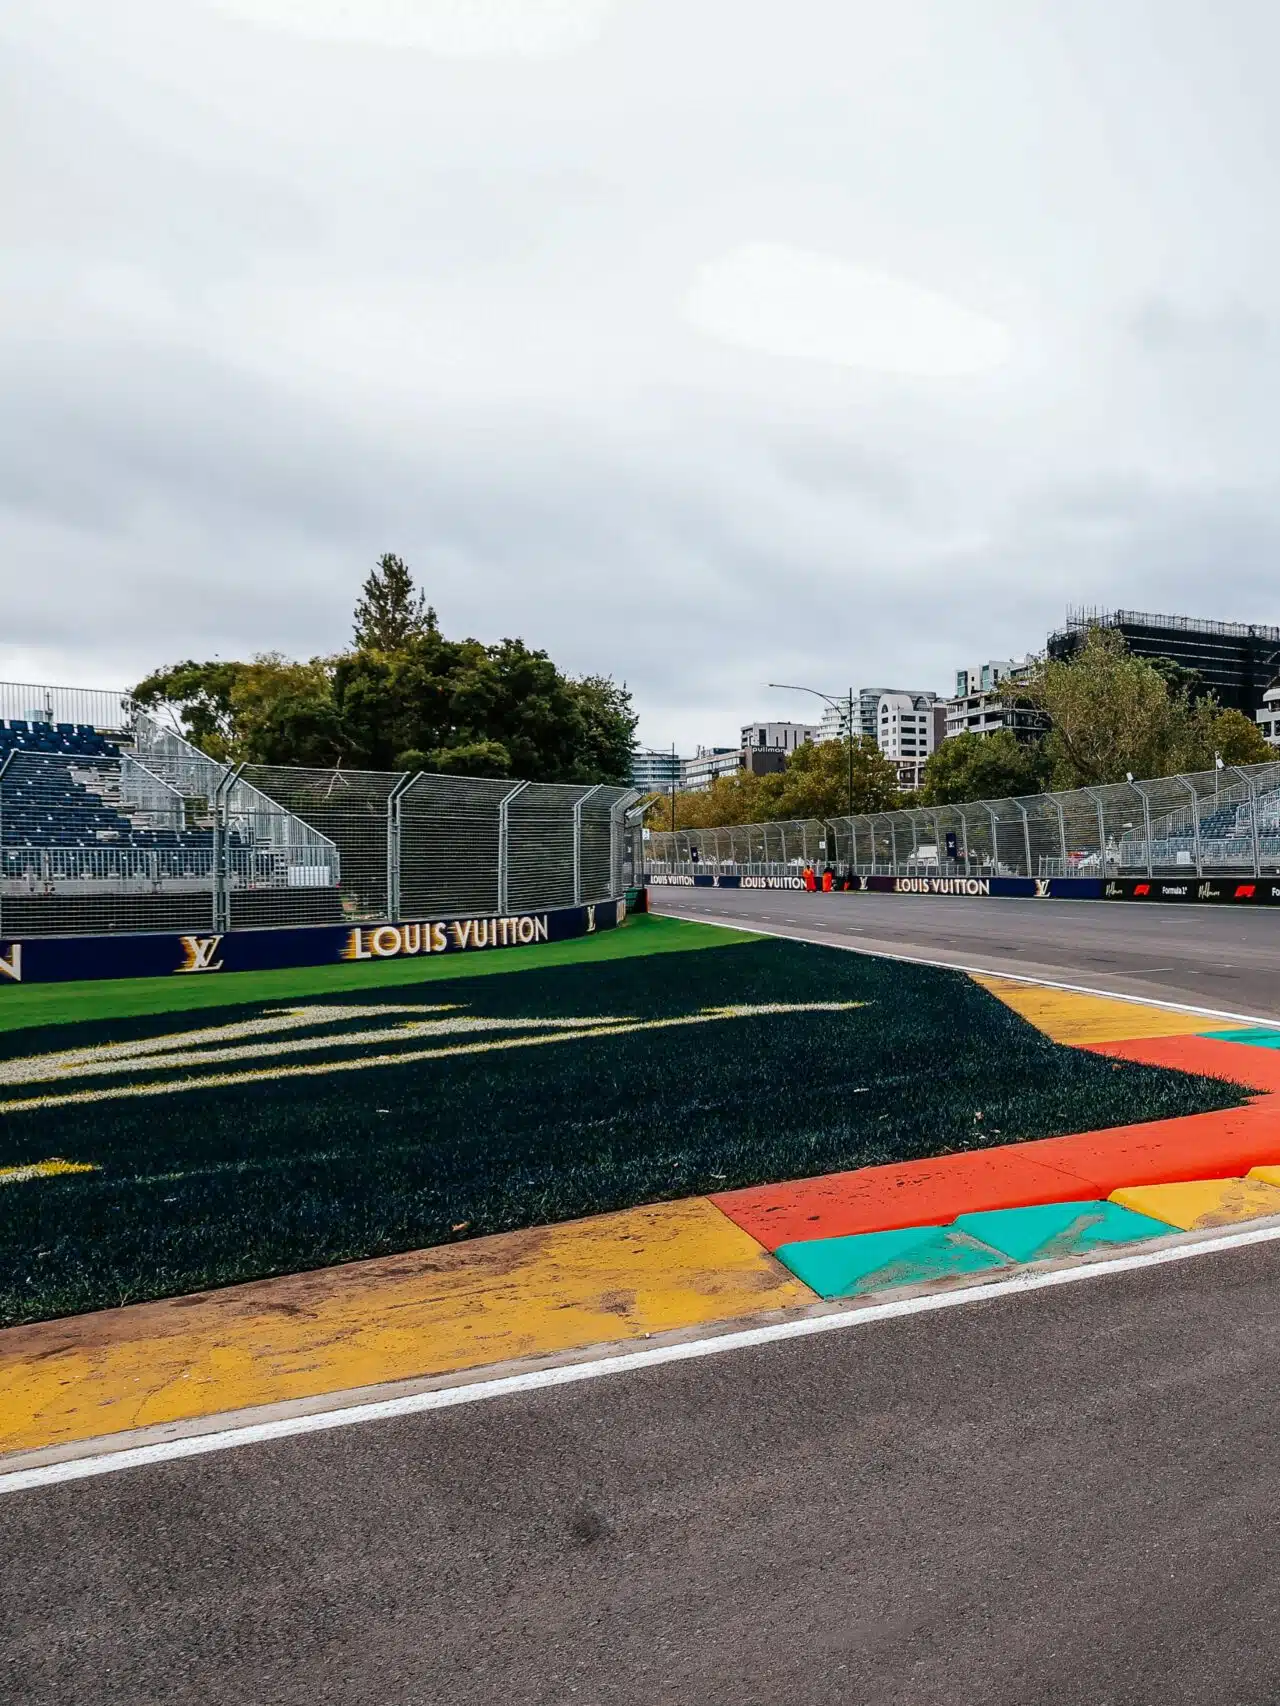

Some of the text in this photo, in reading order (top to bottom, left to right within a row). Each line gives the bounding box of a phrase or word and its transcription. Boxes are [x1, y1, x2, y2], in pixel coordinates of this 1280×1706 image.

[752, 746, 786, 754] pullman
[651, 875, 695, 886] LOUIS VUITTON
[741, 876, 765, 888] LOUIS
[896, 878, 990, 895] LOUIS VUITTON
[1162, 886, 1182, 895] Formula
[355, 914, 548, 959] LOUIS VUITTON
